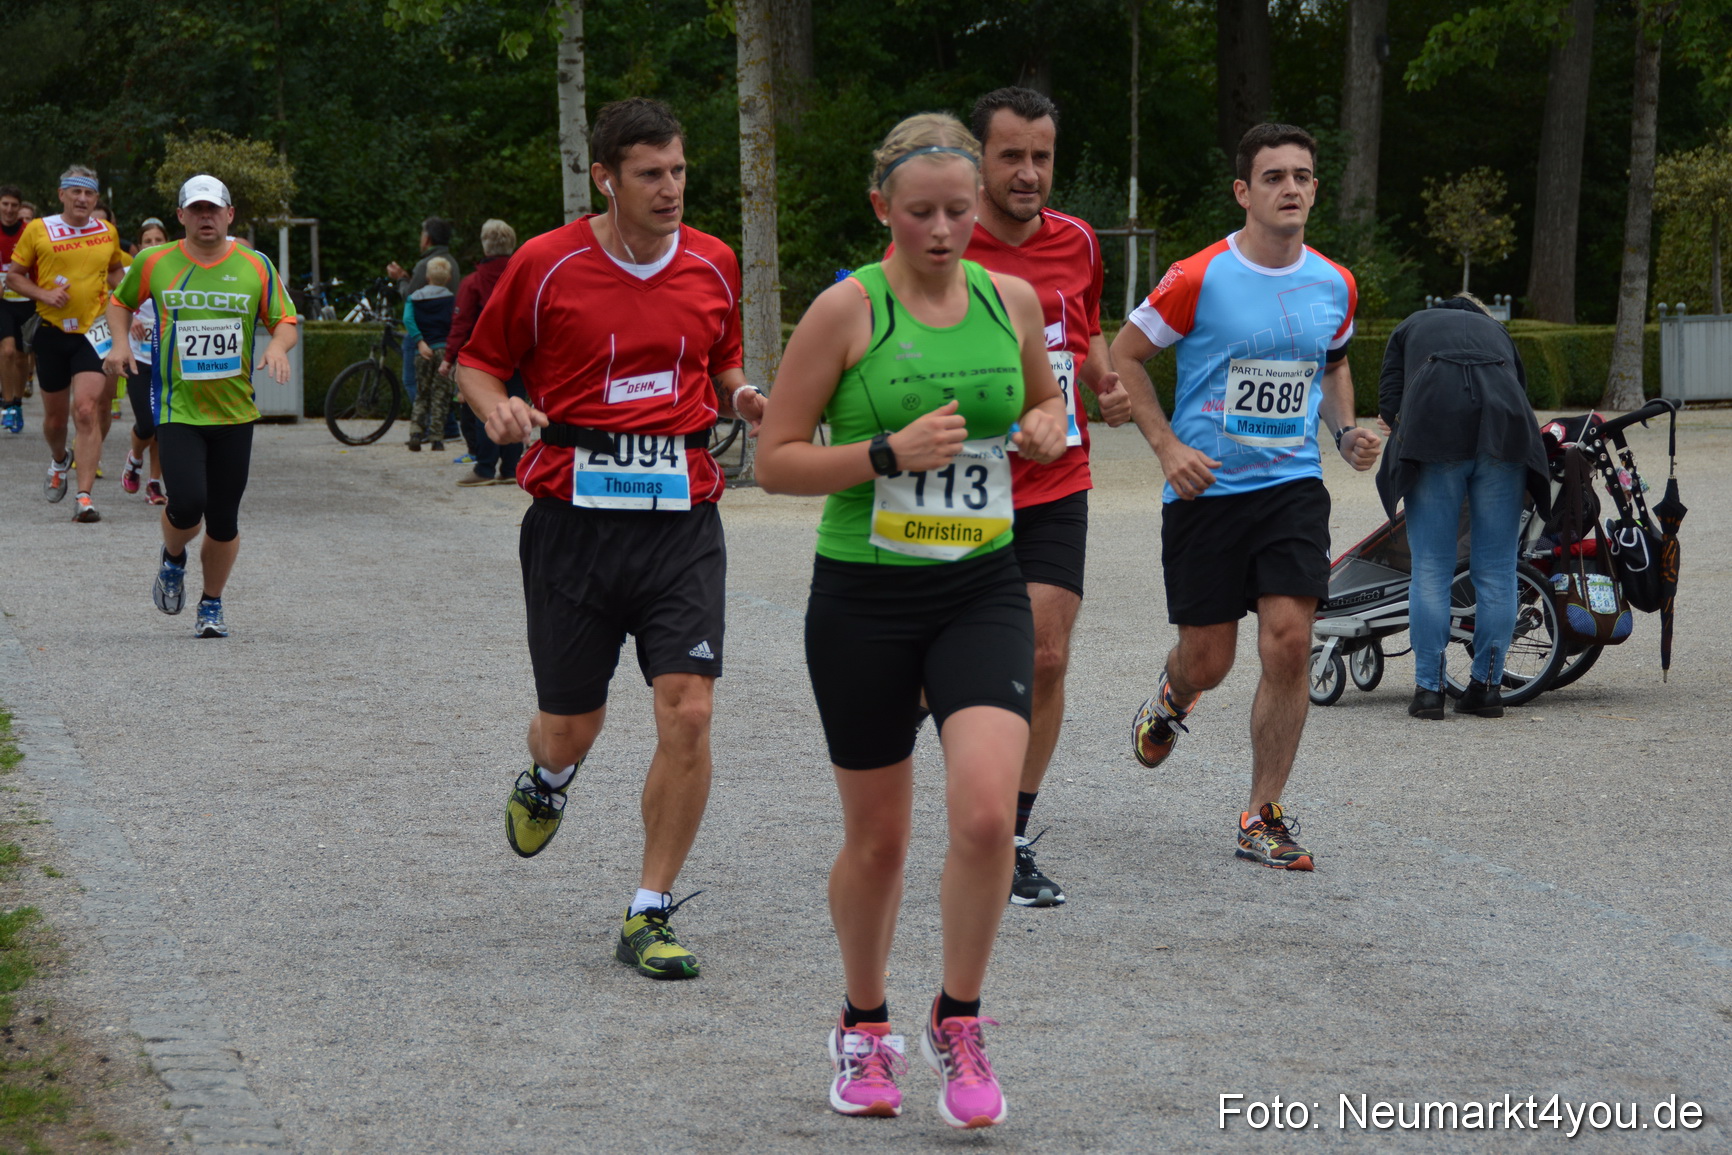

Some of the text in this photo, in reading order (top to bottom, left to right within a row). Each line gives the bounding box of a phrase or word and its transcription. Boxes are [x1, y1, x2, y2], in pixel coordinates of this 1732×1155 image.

[53, 235, 114, 253] MAX BÖGL
[162, 290, 251, 314] BOCK
[185, 333, 238, 356] 2794
[197, 362, 229, 371] Markus
[1231, 366, 1303, 378] PARTL Neumarkt
[627, 381, 656, 394] DEHN
[1235, 380, 1305, 414] 2689
[1237, 419, 1297, 435] Maximilian
[604, 477, 663, 494] Thomas
[904, 521, 983, 542] Christina
[689, 649, 714, 660] adidas
